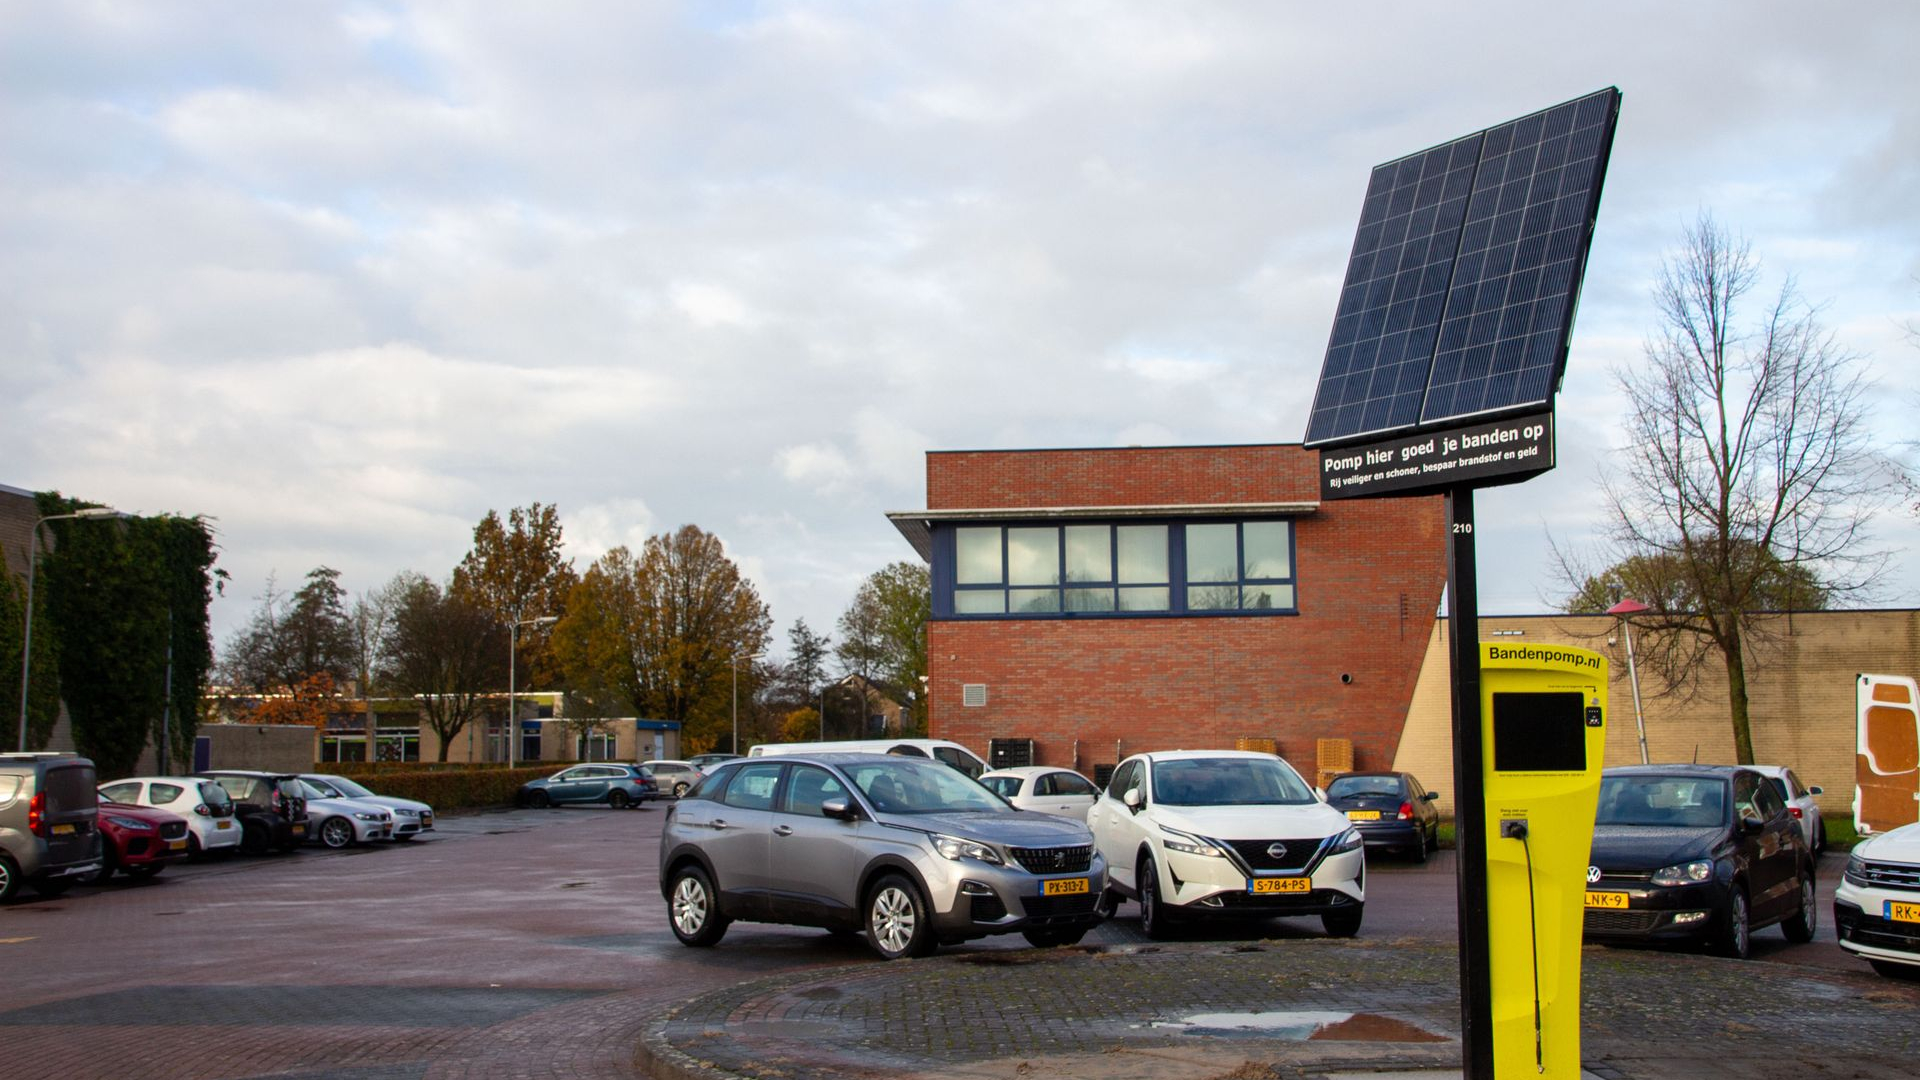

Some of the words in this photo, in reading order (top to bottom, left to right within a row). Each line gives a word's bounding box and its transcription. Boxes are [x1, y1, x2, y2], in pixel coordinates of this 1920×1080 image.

[1325, 457, 1363, 472] Pomp
[1366, 449, 1394, 465] hier
[1401, 439, 1434, 461] goed
[1442, 437, 1458, 456] je
[1462, 428, 1518, 449] banden
[1523, 424, 1544, 440] op
[1330, 477, 1341, 489] Rij
[1342, 473, 1372, 485] veiliger
[1374, 471, 1384, 480] en
[1385, 467, 1421, 479] schoner,
[1423, 460, 1457, 473] bespaar
[1459, 451, 1502, 467] brandstof
[1503, 450, 1515, 460] en
[1517, 445, 1538, 460] geld
[1453, 523, 1472, 533] 210
[1489, 646, 1601, 669] Bandenpomp.nl
[1048, 881, 1084, 893] PX-313-Z
[1257, 880, 1306, 891] S-784-PS
